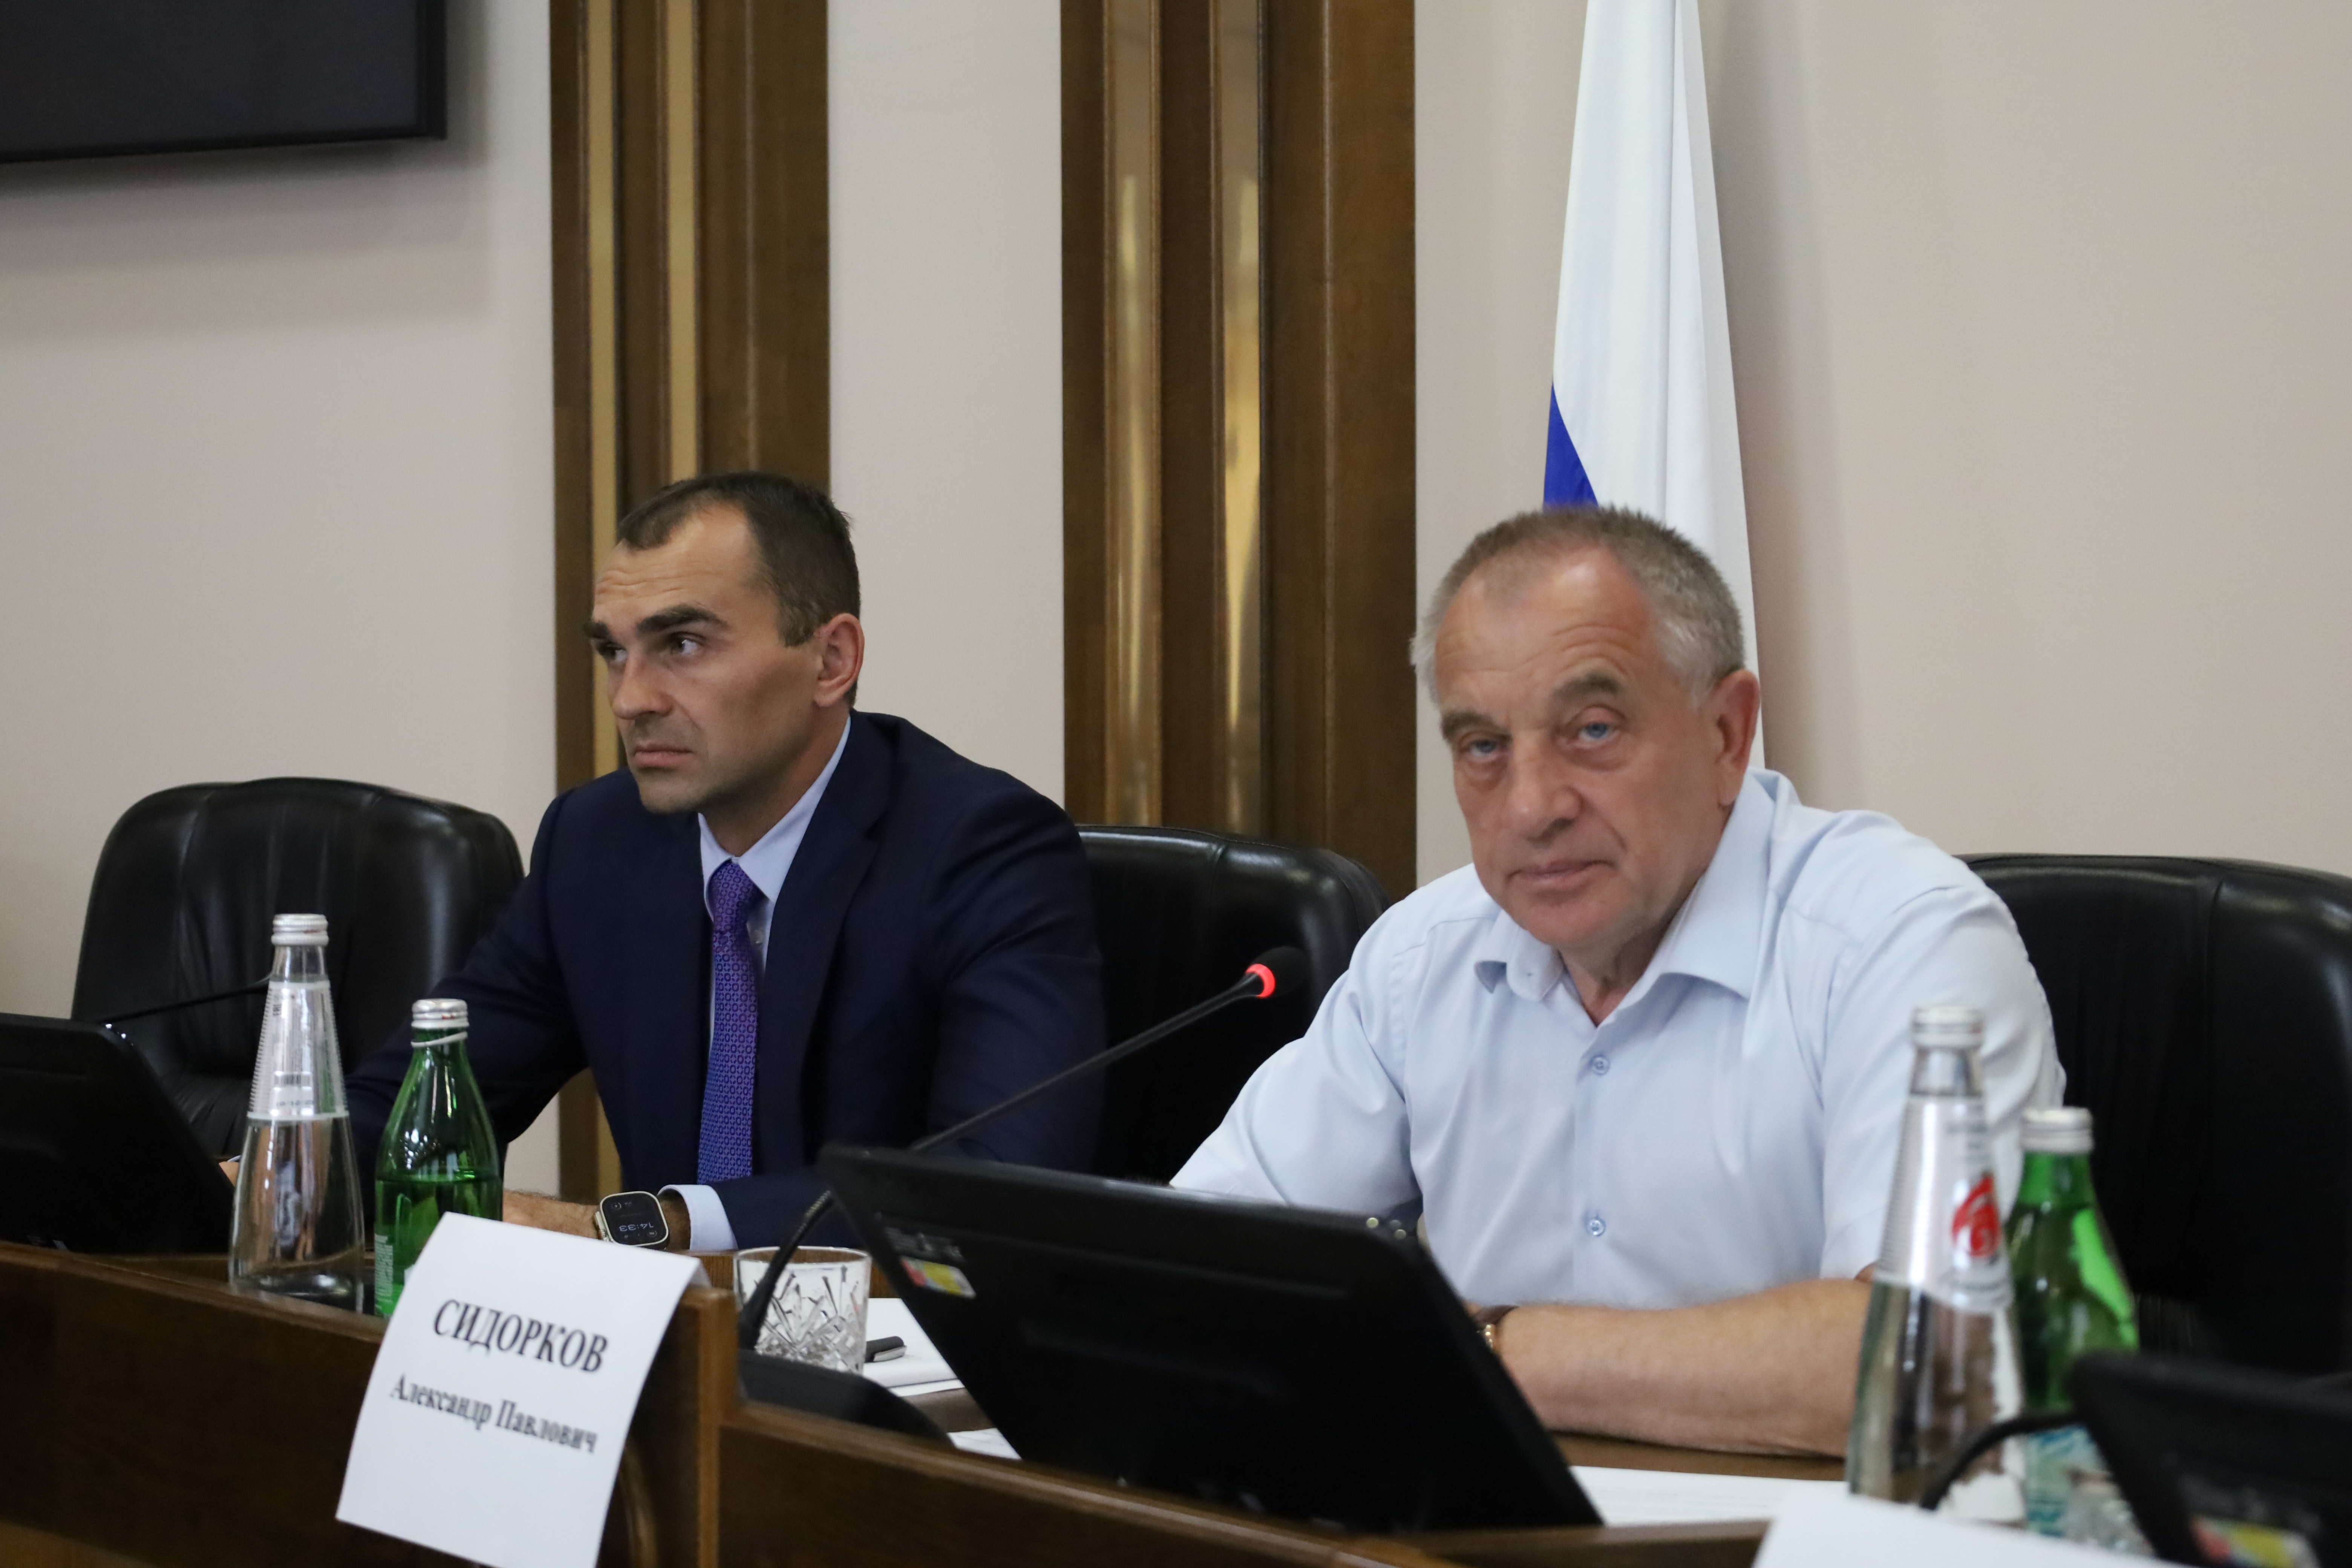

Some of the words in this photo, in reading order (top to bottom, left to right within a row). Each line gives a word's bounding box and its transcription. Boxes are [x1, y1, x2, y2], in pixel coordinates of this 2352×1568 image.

[619, 1222, 654, 1231] 14:33
[433, 1299, 608, 1372] СИДОРКОВ
[390, 1374, 492, 1430] Александр
[495, 1399, 597, 1454] Павлович
